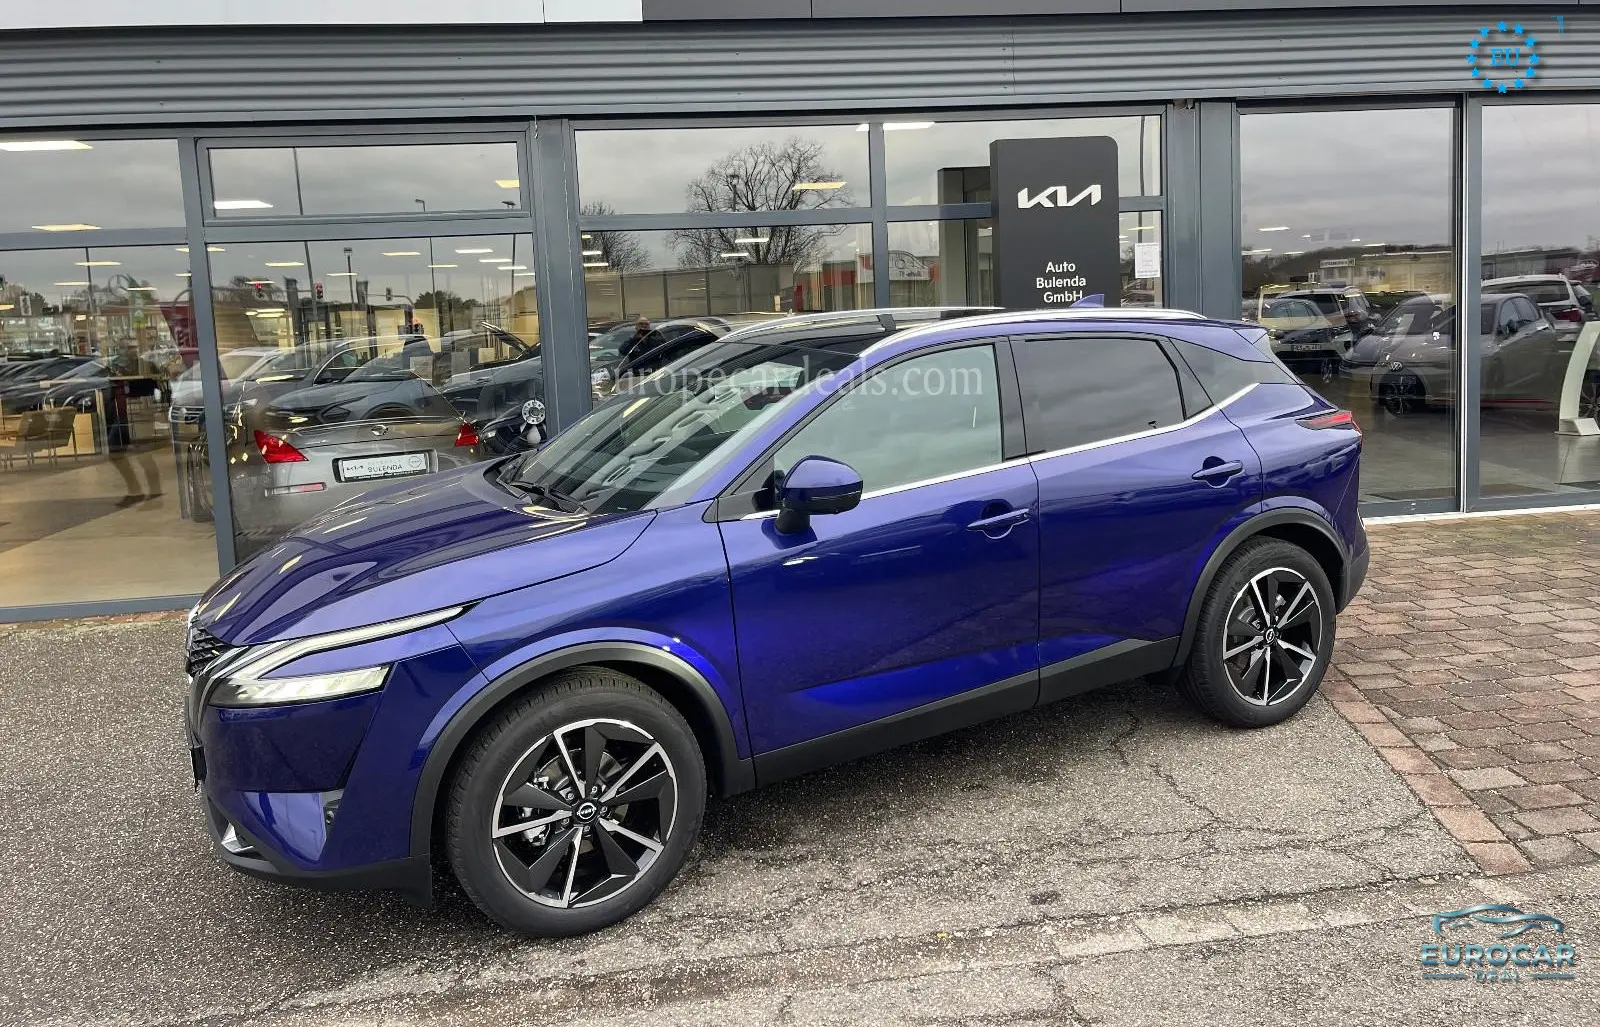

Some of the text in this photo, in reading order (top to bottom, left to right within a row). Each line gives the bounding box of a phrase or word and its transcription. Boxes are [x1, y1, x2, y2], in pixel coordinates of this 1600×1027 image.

[1018, 184, 1101, 208] KIA
[1046, 261, 1076, 273] Auto
[1036, 276, 1087, 289] Bulenda
[1043, 291, 1083, 303] GmbH
